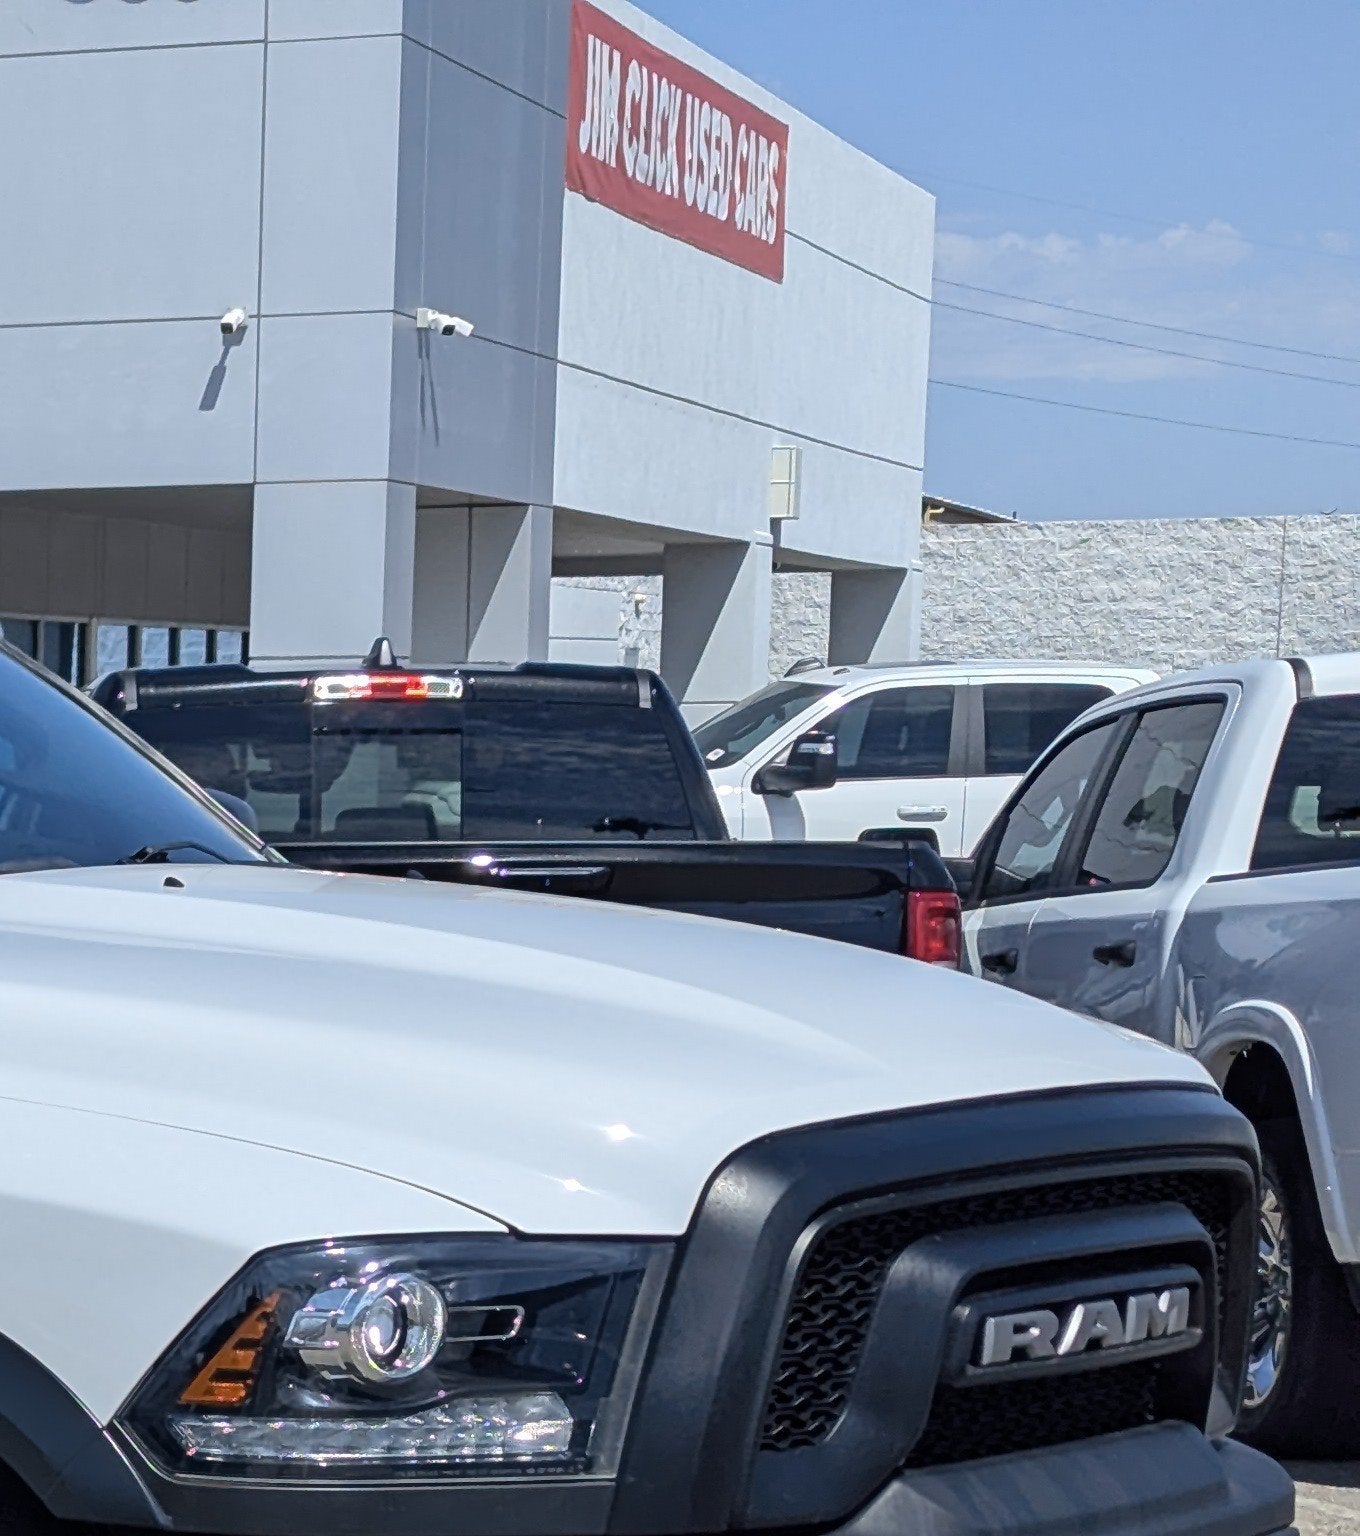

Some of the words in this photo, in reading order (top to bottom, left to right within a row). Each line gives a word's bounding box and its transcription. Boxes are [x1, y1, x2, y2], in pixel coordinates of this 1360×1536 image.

[579, 34, 621, 168] JIM
[623, 59, 682, 199] CLICK
[684, 93, 733, 221] USED
[735, 123, 779, 244] CARS
[982, 1286, 1190, 1366] RAM
